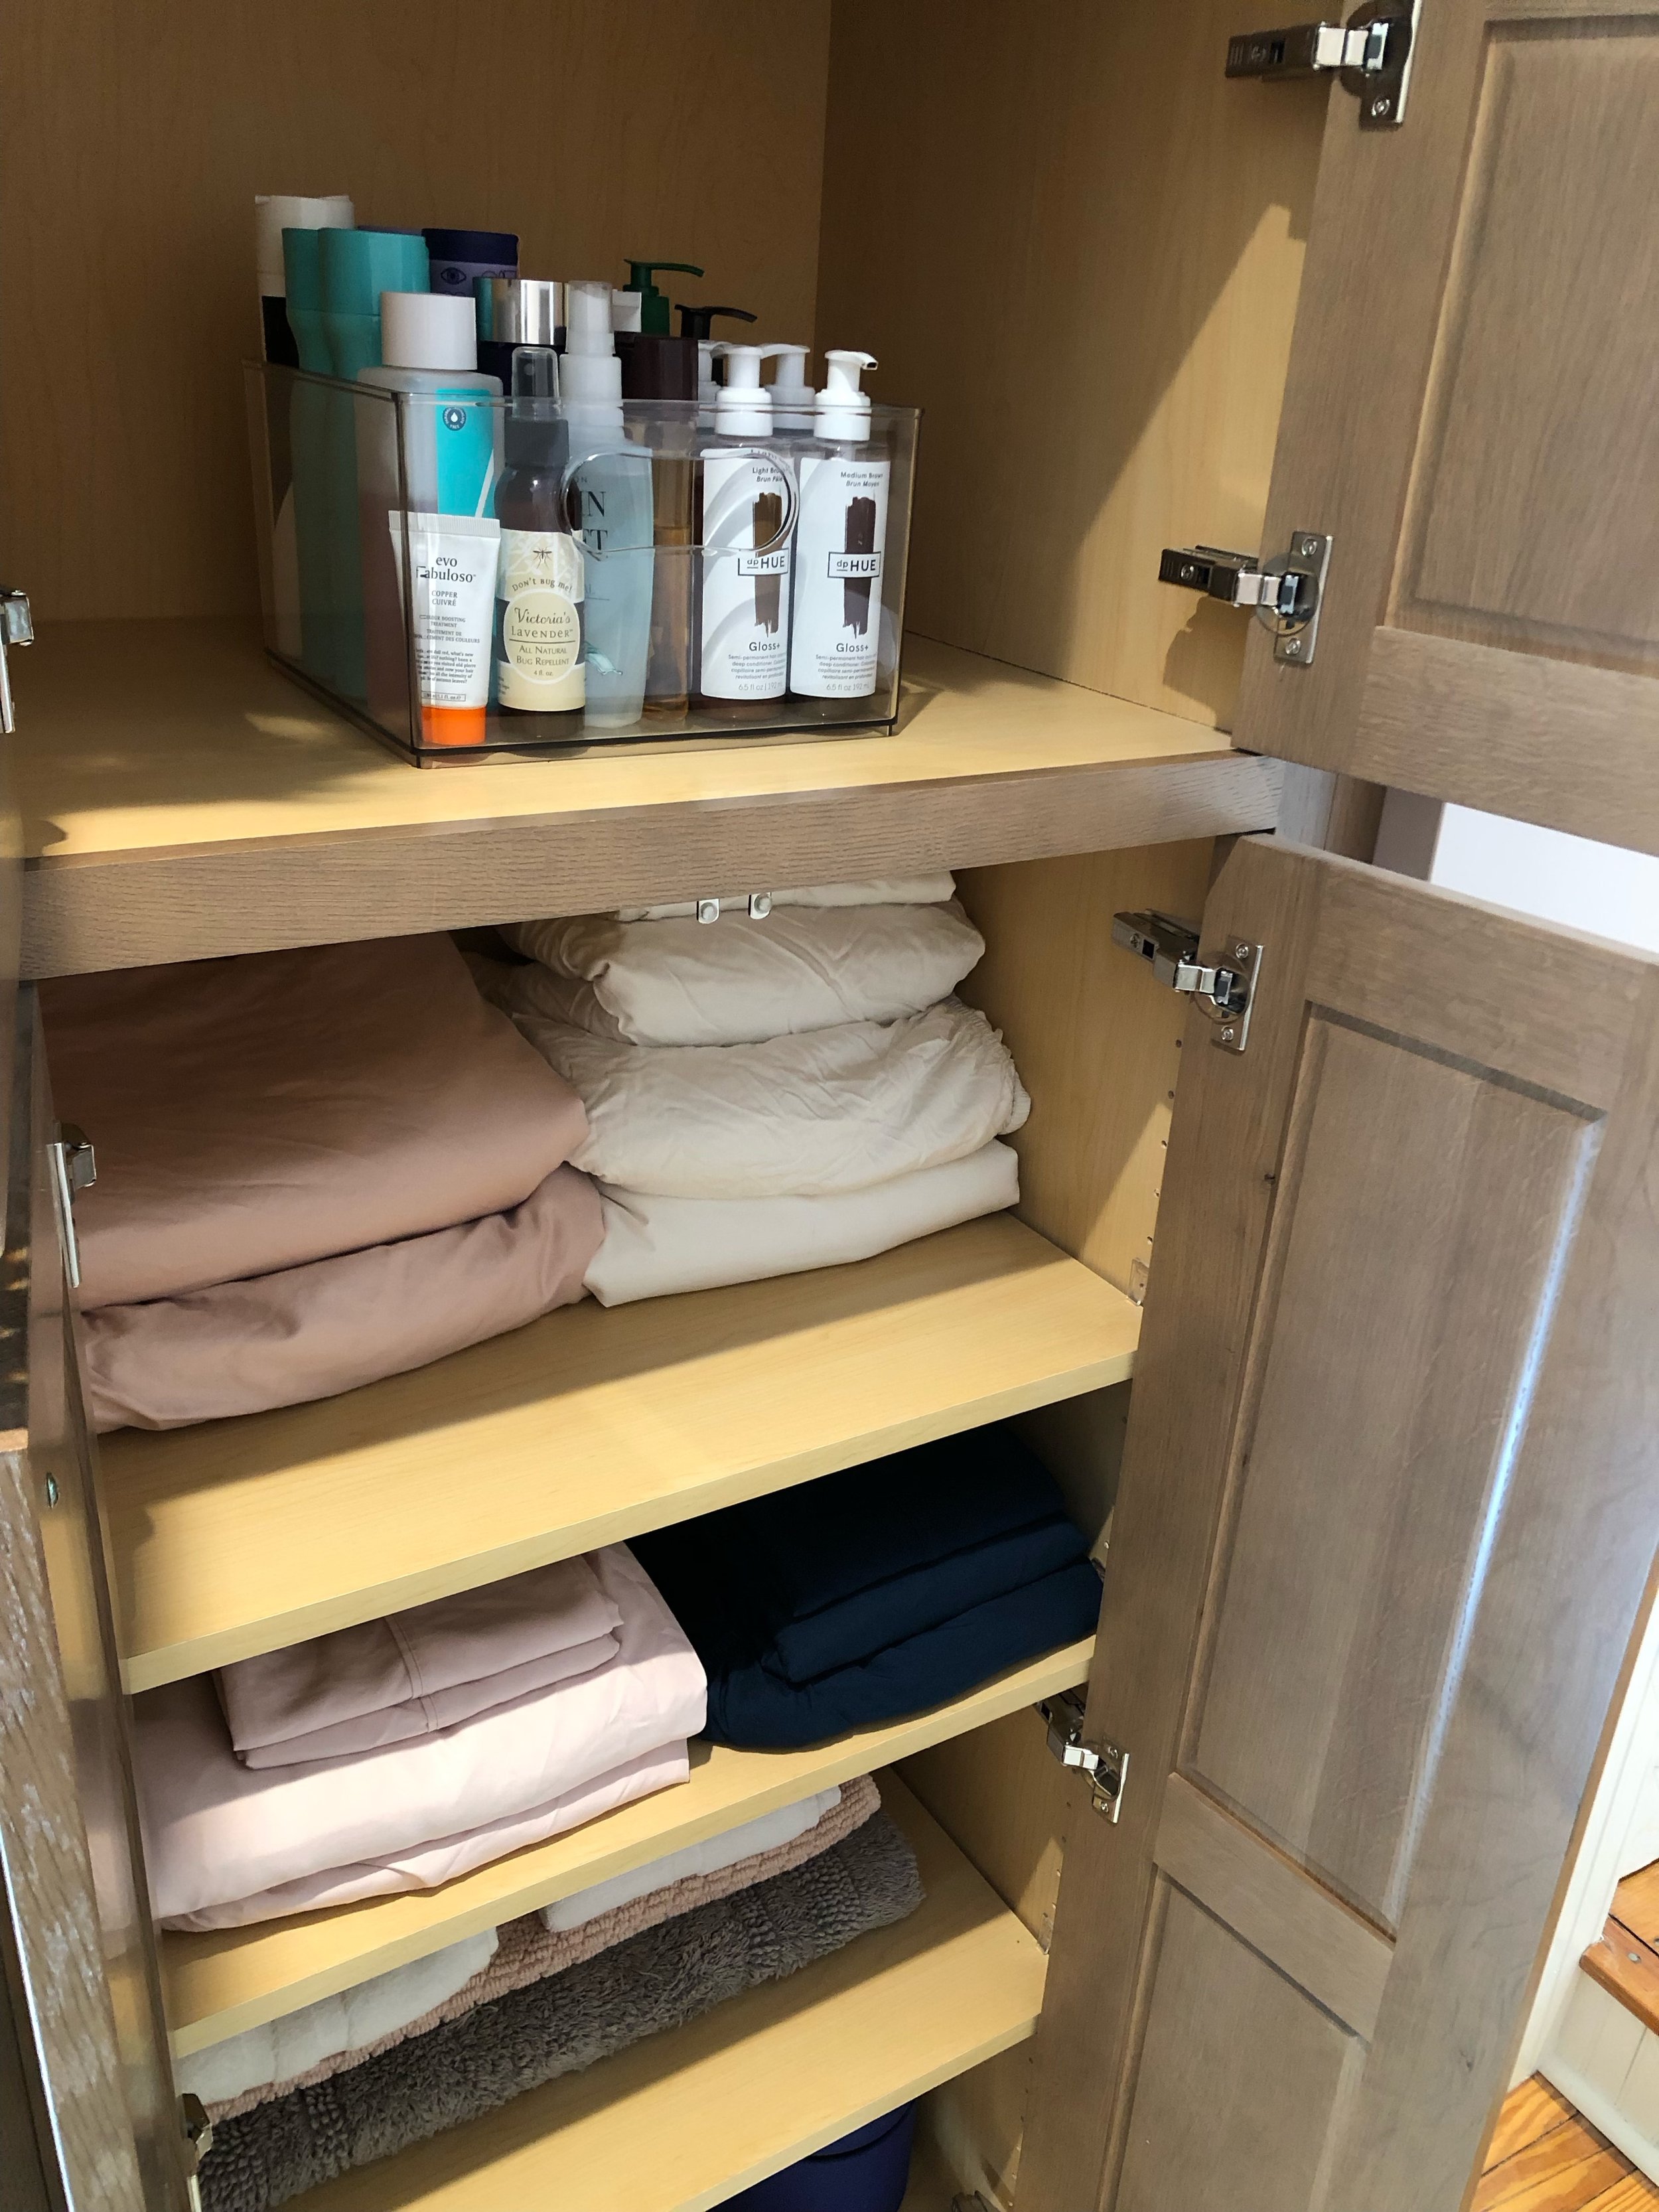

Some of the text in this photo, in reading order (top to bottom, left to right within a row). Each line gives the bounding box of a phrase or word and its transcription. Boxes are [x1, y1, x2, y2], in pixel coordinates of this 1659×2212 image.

[436, 557, 458, 567] evo
[747, 555, 785, 569] dpHUE
[836, 559, 876, 571] dpHUE
[514, 607, 571, 624] Victoria's
[749, 642, 780, 652] Gloss+
[836, 642, 869, 652] Gloss+
